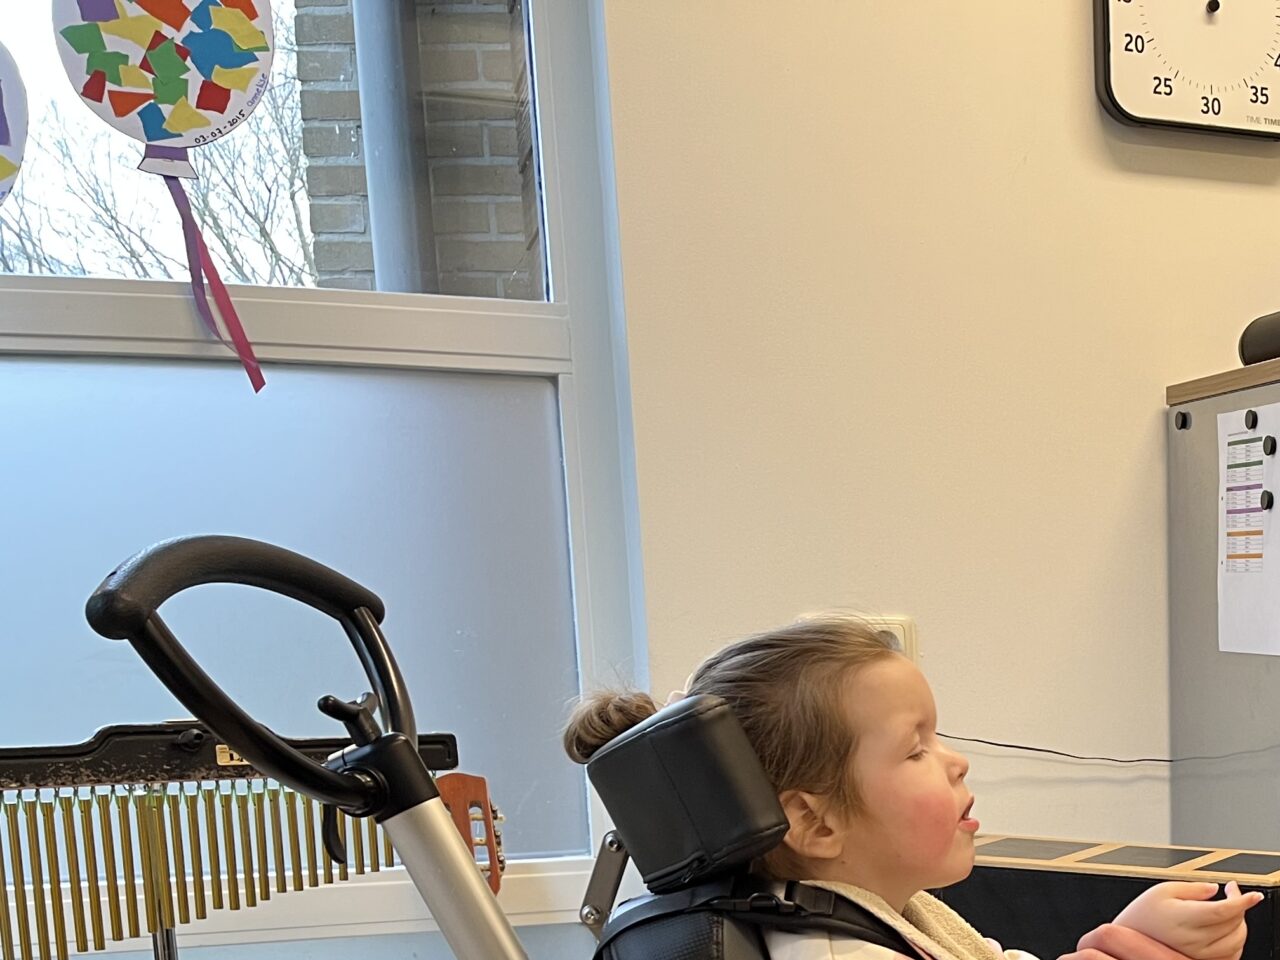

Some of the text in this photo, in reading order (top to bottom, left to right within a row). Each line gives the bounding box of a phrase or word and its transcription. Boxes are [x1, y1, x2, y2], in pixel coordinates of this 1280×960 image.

[1124, 33, 1145, 54] 20
[1152, 76, 1173, 96] 25
[1249, 85, 1270, 105] 35
[1200, 96, 1221, 116] 30
